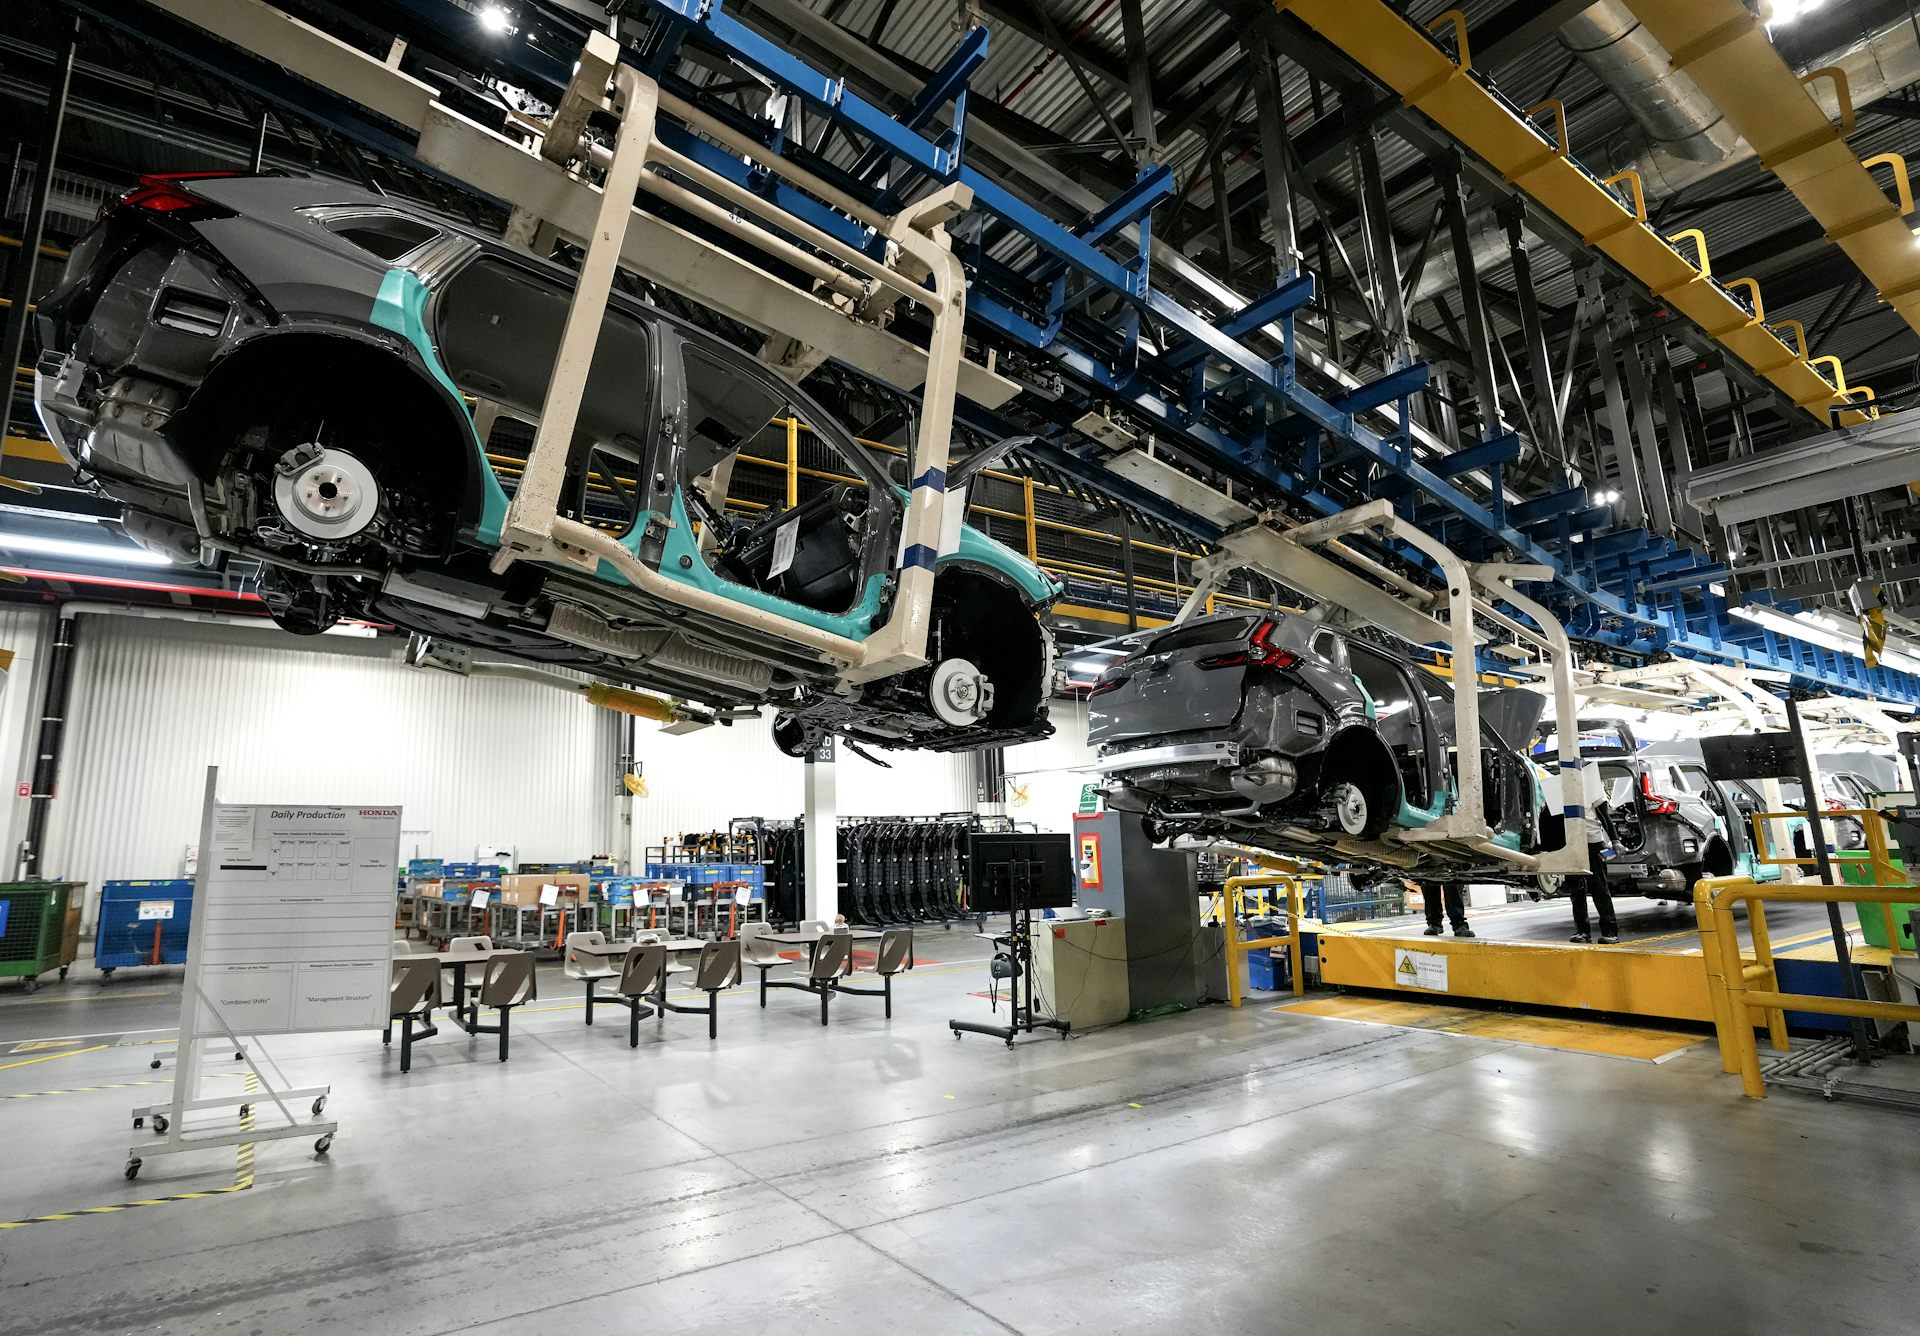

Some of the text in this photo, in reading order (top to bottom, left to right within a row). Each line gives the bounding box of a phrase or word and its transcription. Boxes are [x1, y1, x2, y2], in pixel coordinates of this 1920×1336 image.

[820, 749, 832, 760] 33
[271, 810, 346, 820] Daily Production
